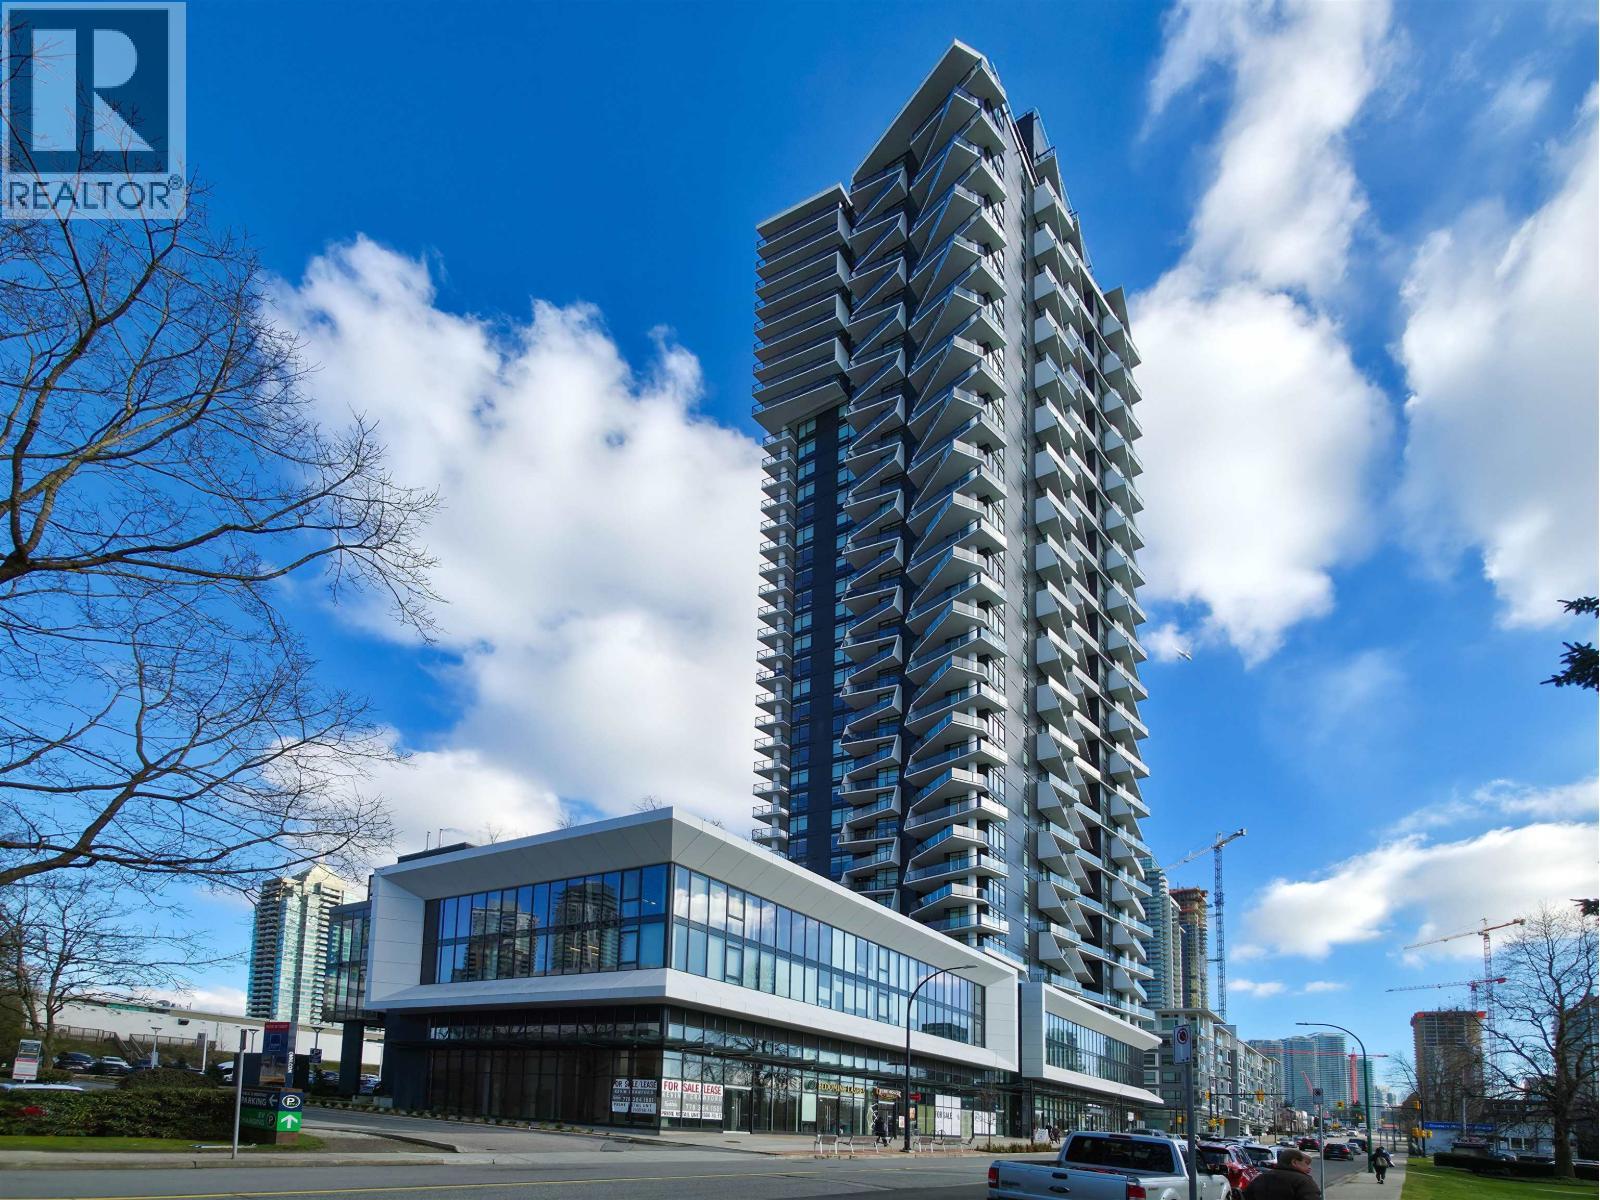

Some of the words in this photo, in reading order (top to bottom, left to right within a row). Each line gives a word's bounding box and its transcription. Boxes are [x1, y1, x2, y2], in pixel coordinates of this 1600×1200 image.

[663, 1081, 678, 1091] FOR
[683, 1083, 699, 1093] SALE
[703, 1085, 721, 1095] LEASE
[286, 1097, 296, 1106] P
